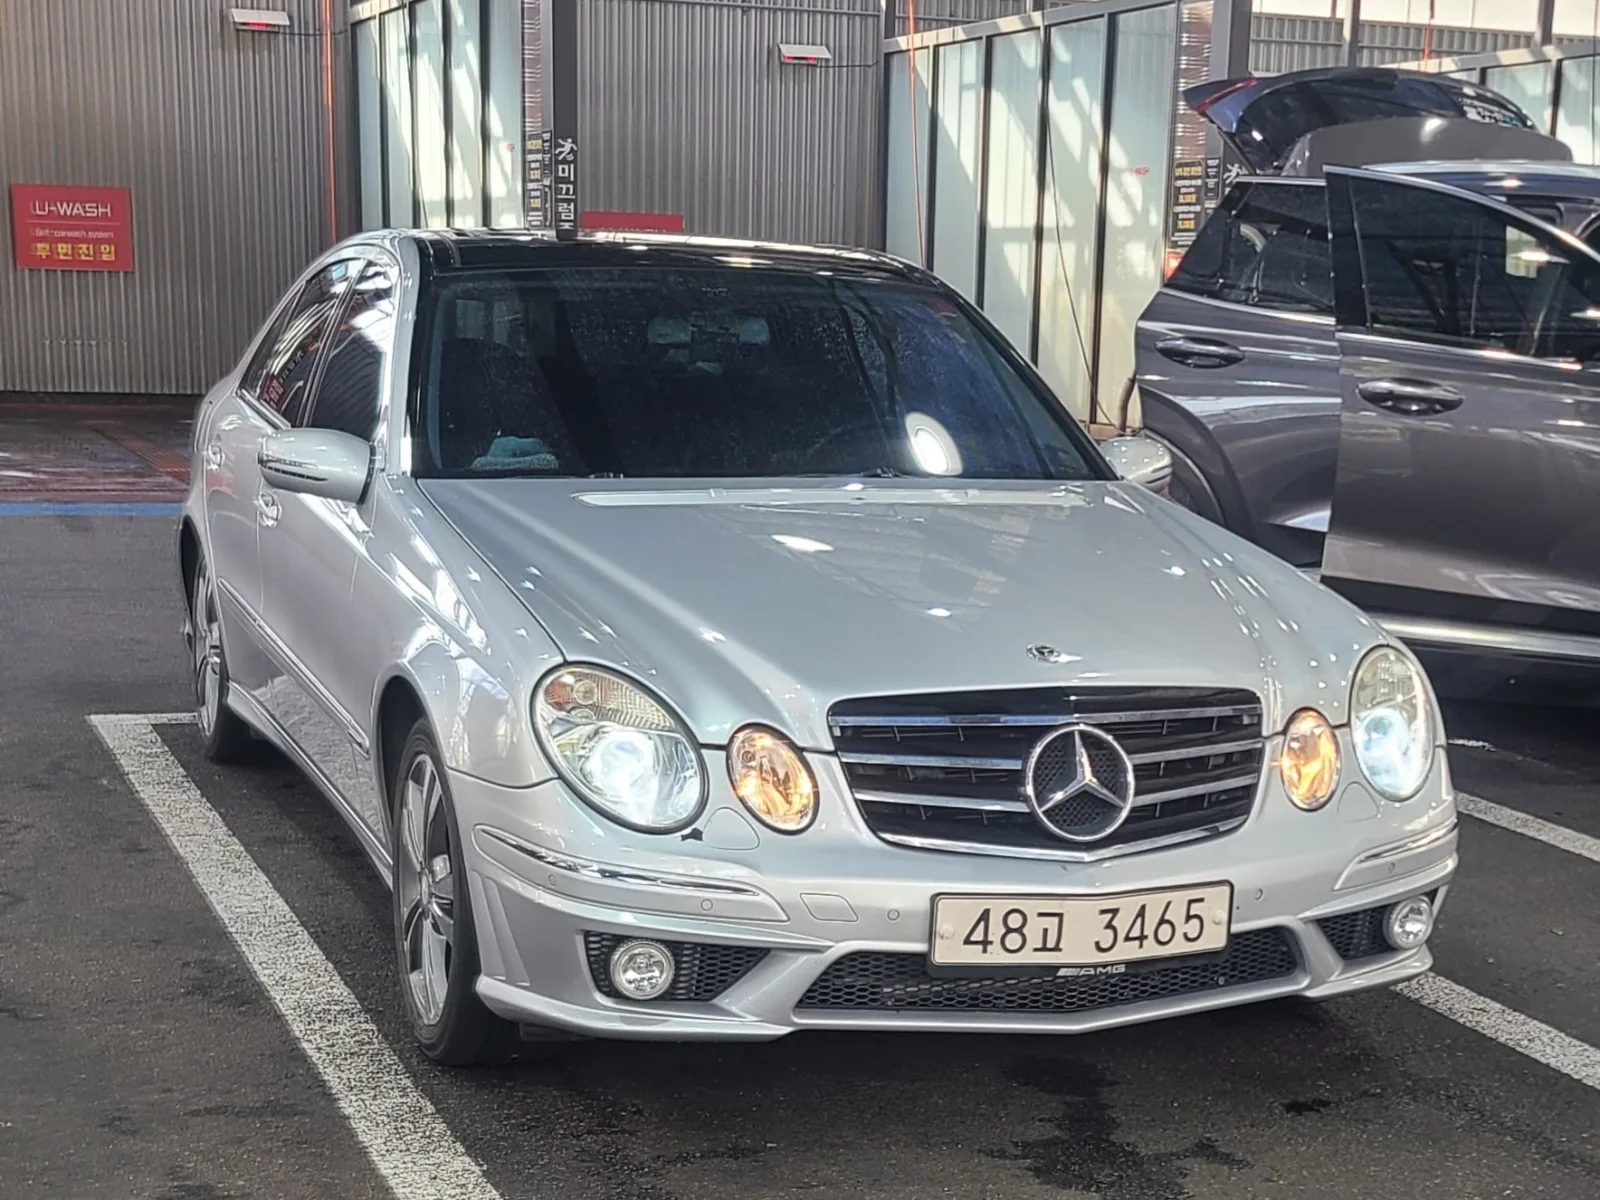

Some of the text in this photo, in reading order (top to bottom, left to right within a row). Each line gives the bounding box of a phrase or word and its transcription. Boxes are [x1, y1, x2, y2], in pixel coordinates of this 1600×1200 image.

[34, 200, 111, 217] U-WASH
[556, 163, 577, 220] 미끄럼
[962, 897, 1206, 954] 48고 3465
[1079, 964, 1126, 976] AMG
